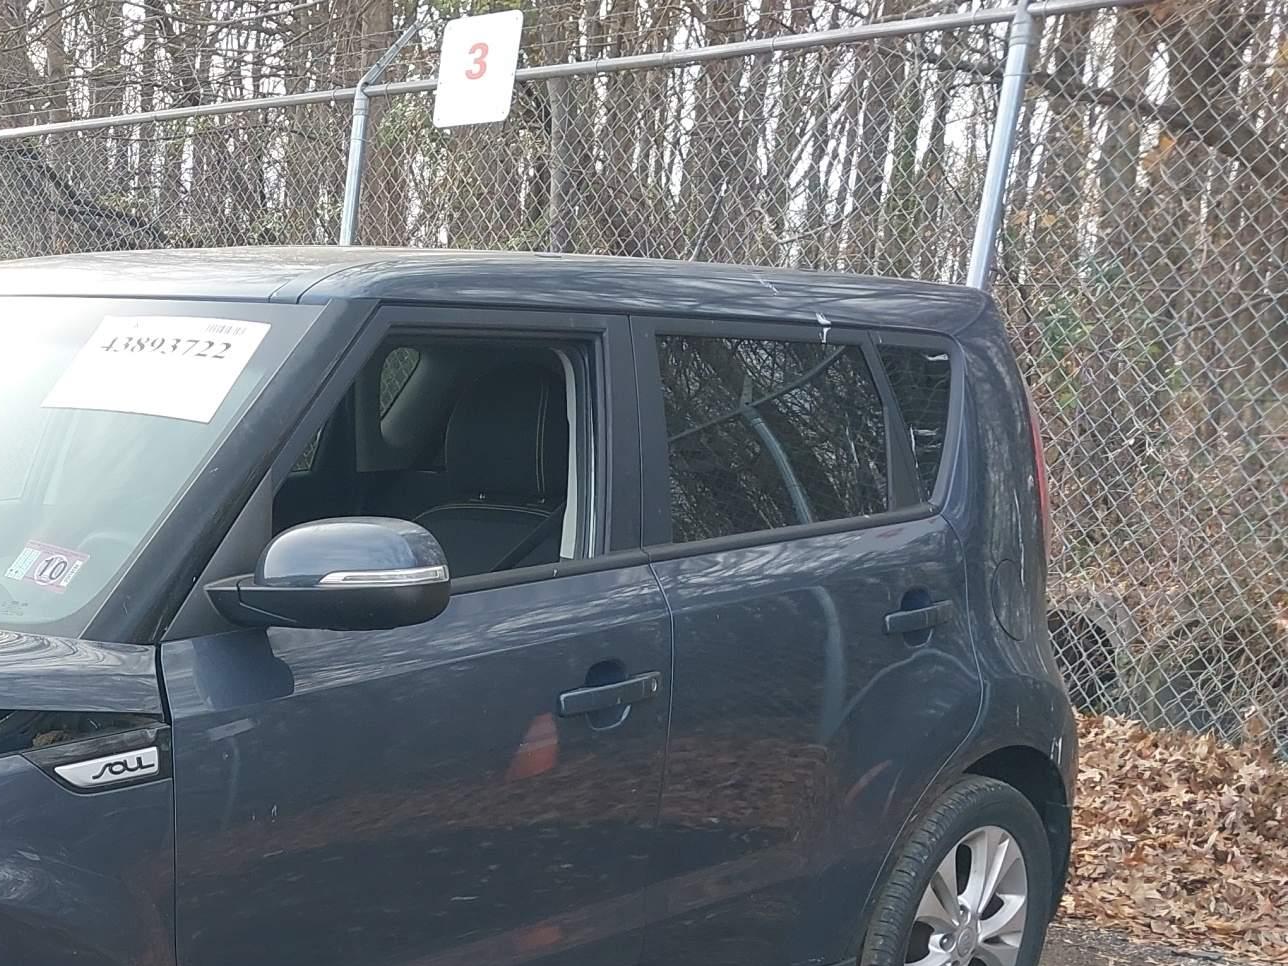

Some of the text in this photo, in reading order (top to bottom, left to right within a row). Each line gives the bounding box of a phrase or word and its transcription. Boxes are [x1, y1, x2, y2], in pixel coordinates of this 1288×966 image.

[465, 42, 489, 80] 3
[100, 336, 232, 360] 43893722
[38, 557, 68, 581] 10
[92, 757, 155, 780] SOUL
